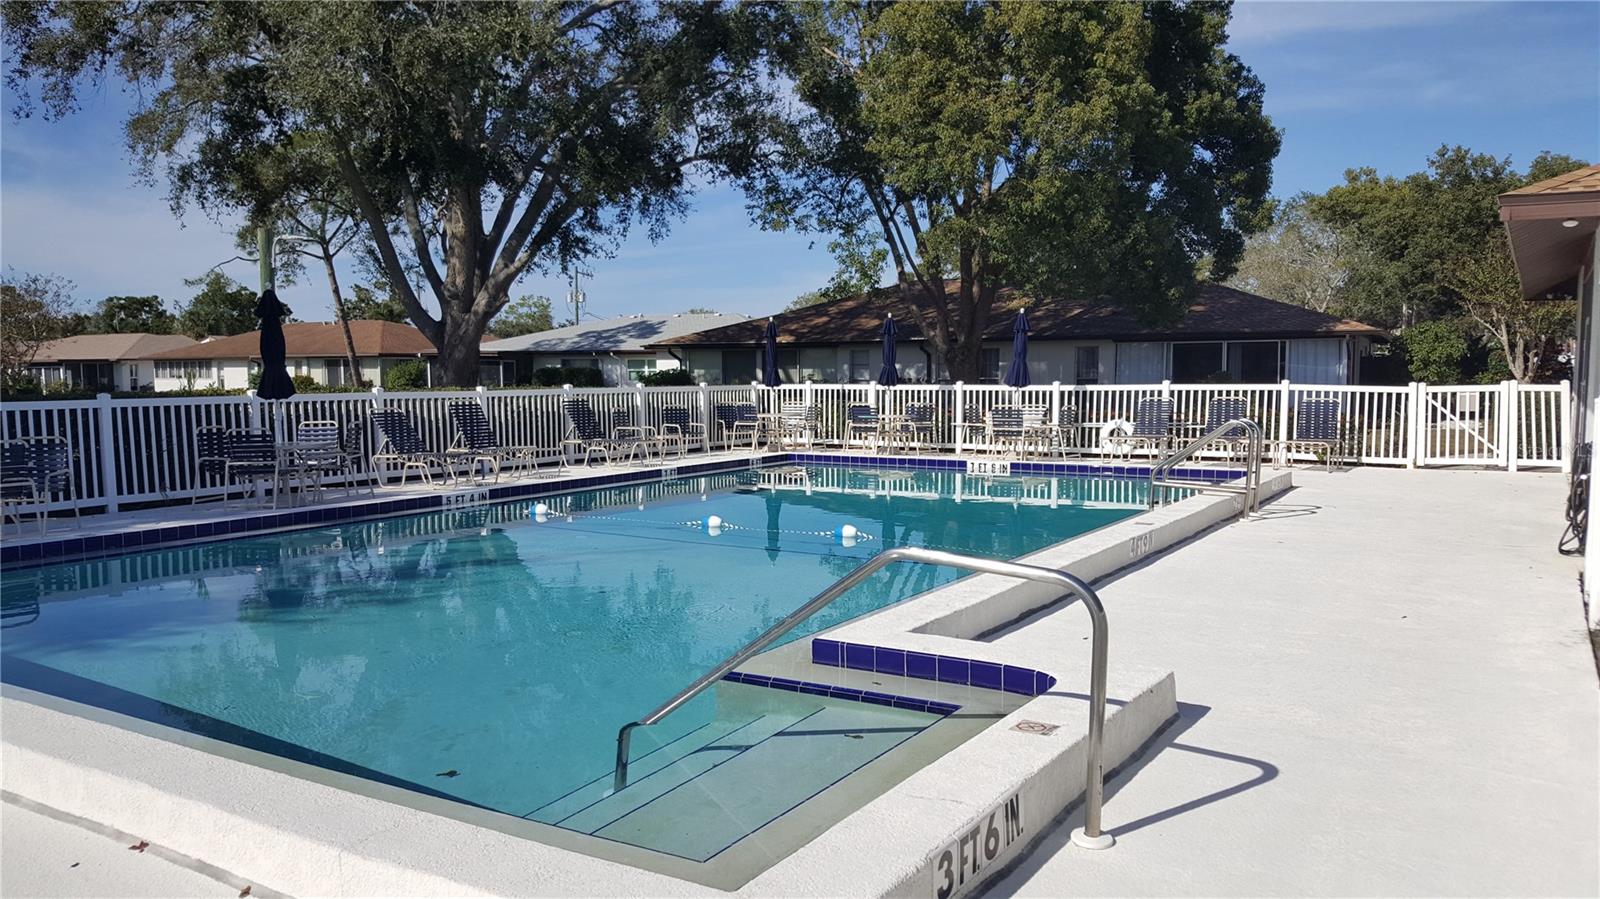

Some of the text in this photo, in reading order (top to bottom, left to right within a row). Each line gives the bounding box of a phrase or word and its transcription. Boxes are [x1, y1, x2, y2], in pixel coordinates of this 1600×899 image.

[455, 494, 465, 504] FT
[469, 493, 475, 502] 4
[478, 492, 487, 502] IN
[937, 792, 1024, 899] 3 FT. 6 IN.
